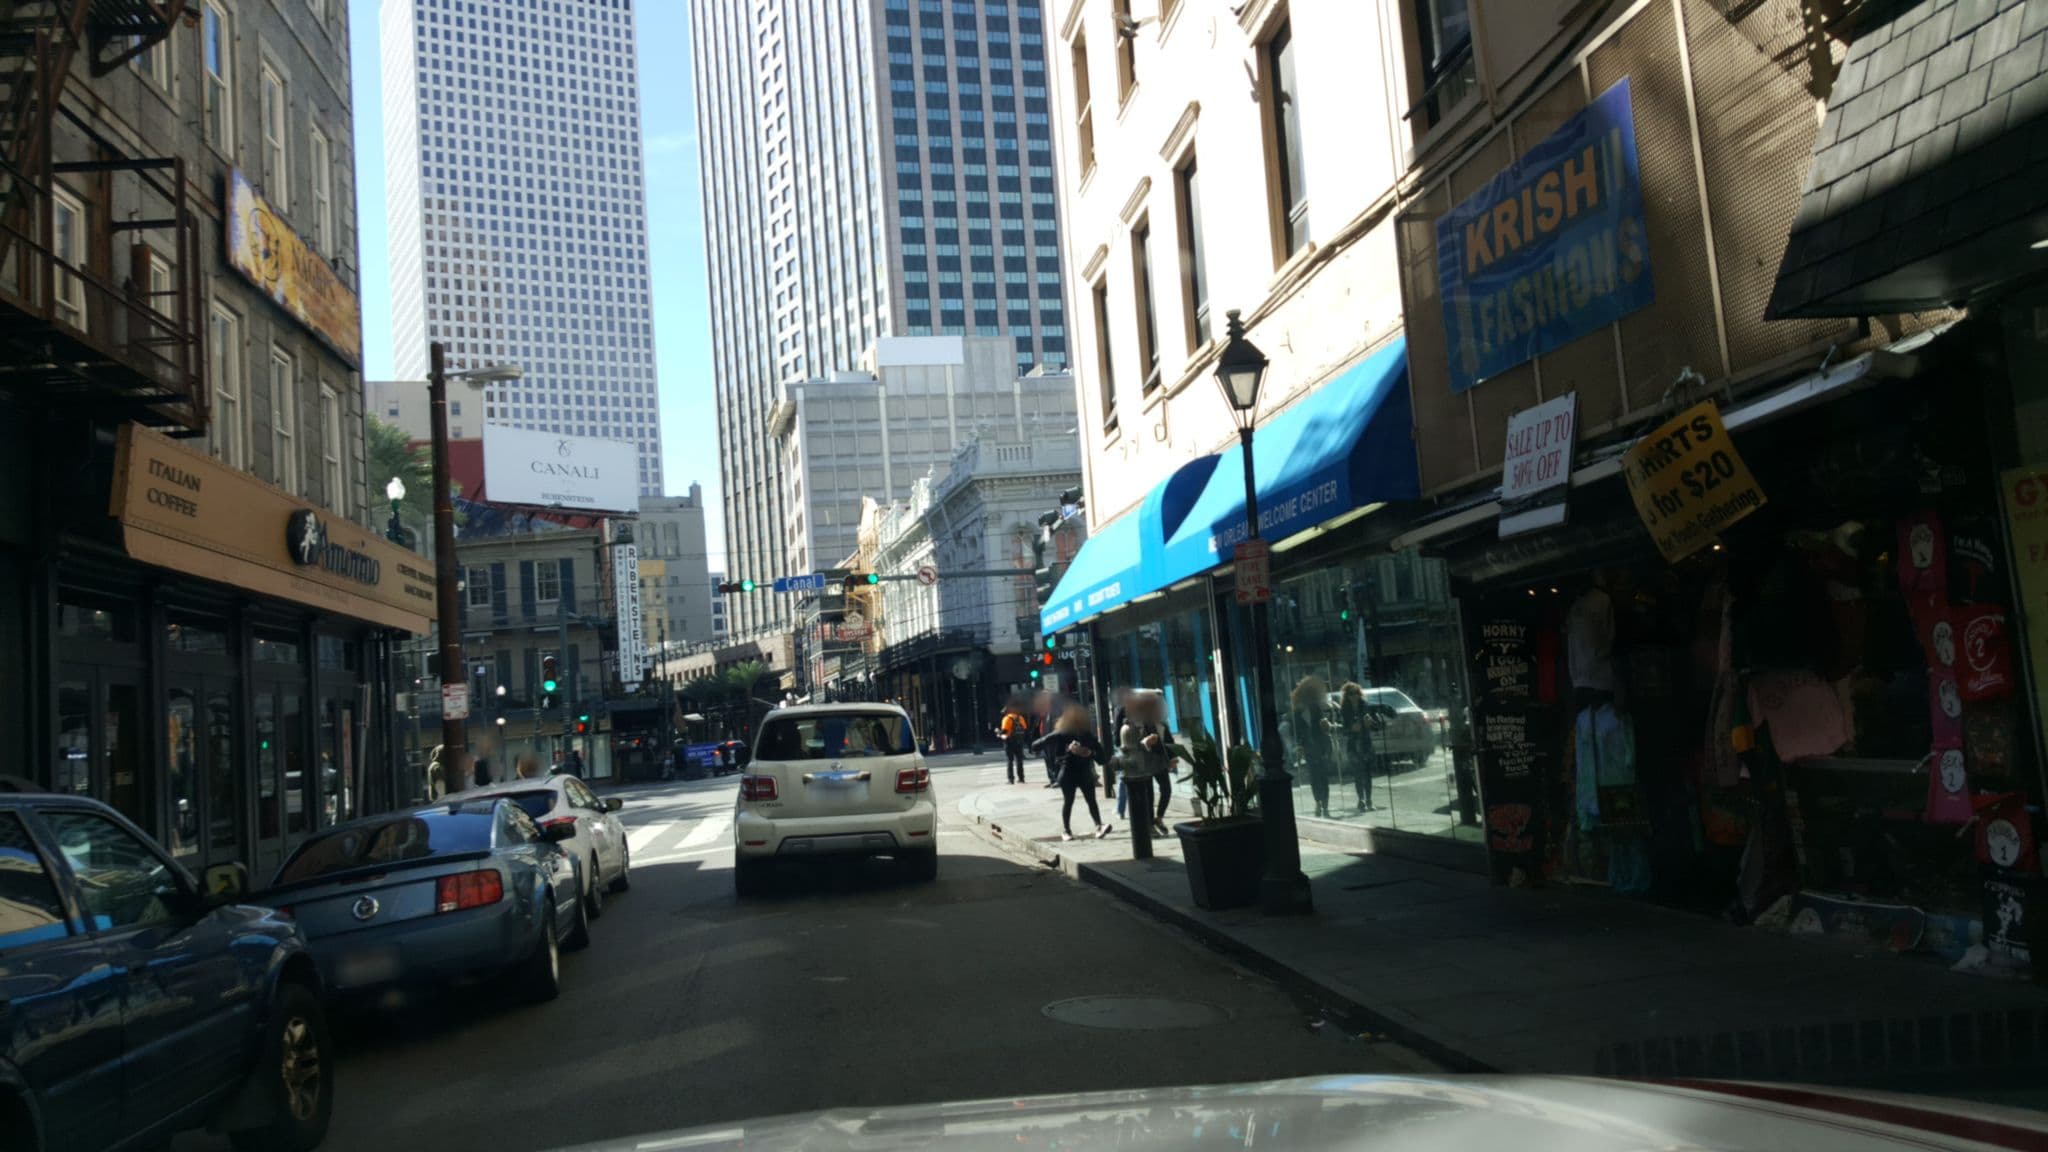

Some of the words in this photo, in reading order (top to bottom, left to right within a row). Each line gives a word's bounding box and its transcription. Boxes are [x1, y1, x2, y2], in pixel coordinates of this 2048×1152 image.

[1464, 145, 1599, 273] KRISH
[1478, 213, 1644, 356] FASHIONS
[1507, 427, 1534, 460] SALE
[1536, 419, 1552, 450] UP
[1555, 411, 1571, 443] TO
[149, 458, 201, 492] ITALIAN
[530, 460, 599, 480] CANALI
[1536, 449, 1562, 481] OFF
[1681, 450, 1734, 499] $20
[147, 487, 198, 518] COFFEE
[1257, 499, 1297, 530] WELCOME
[1300, 480, 1338, 513] CENTER
[319, 520, 379, 585] Amorino
[786, 575, 816, 591] Canal
[629, 548, 643, 676] RUBENSTEINS
[1483, 624, 1526, 638] HORNY
